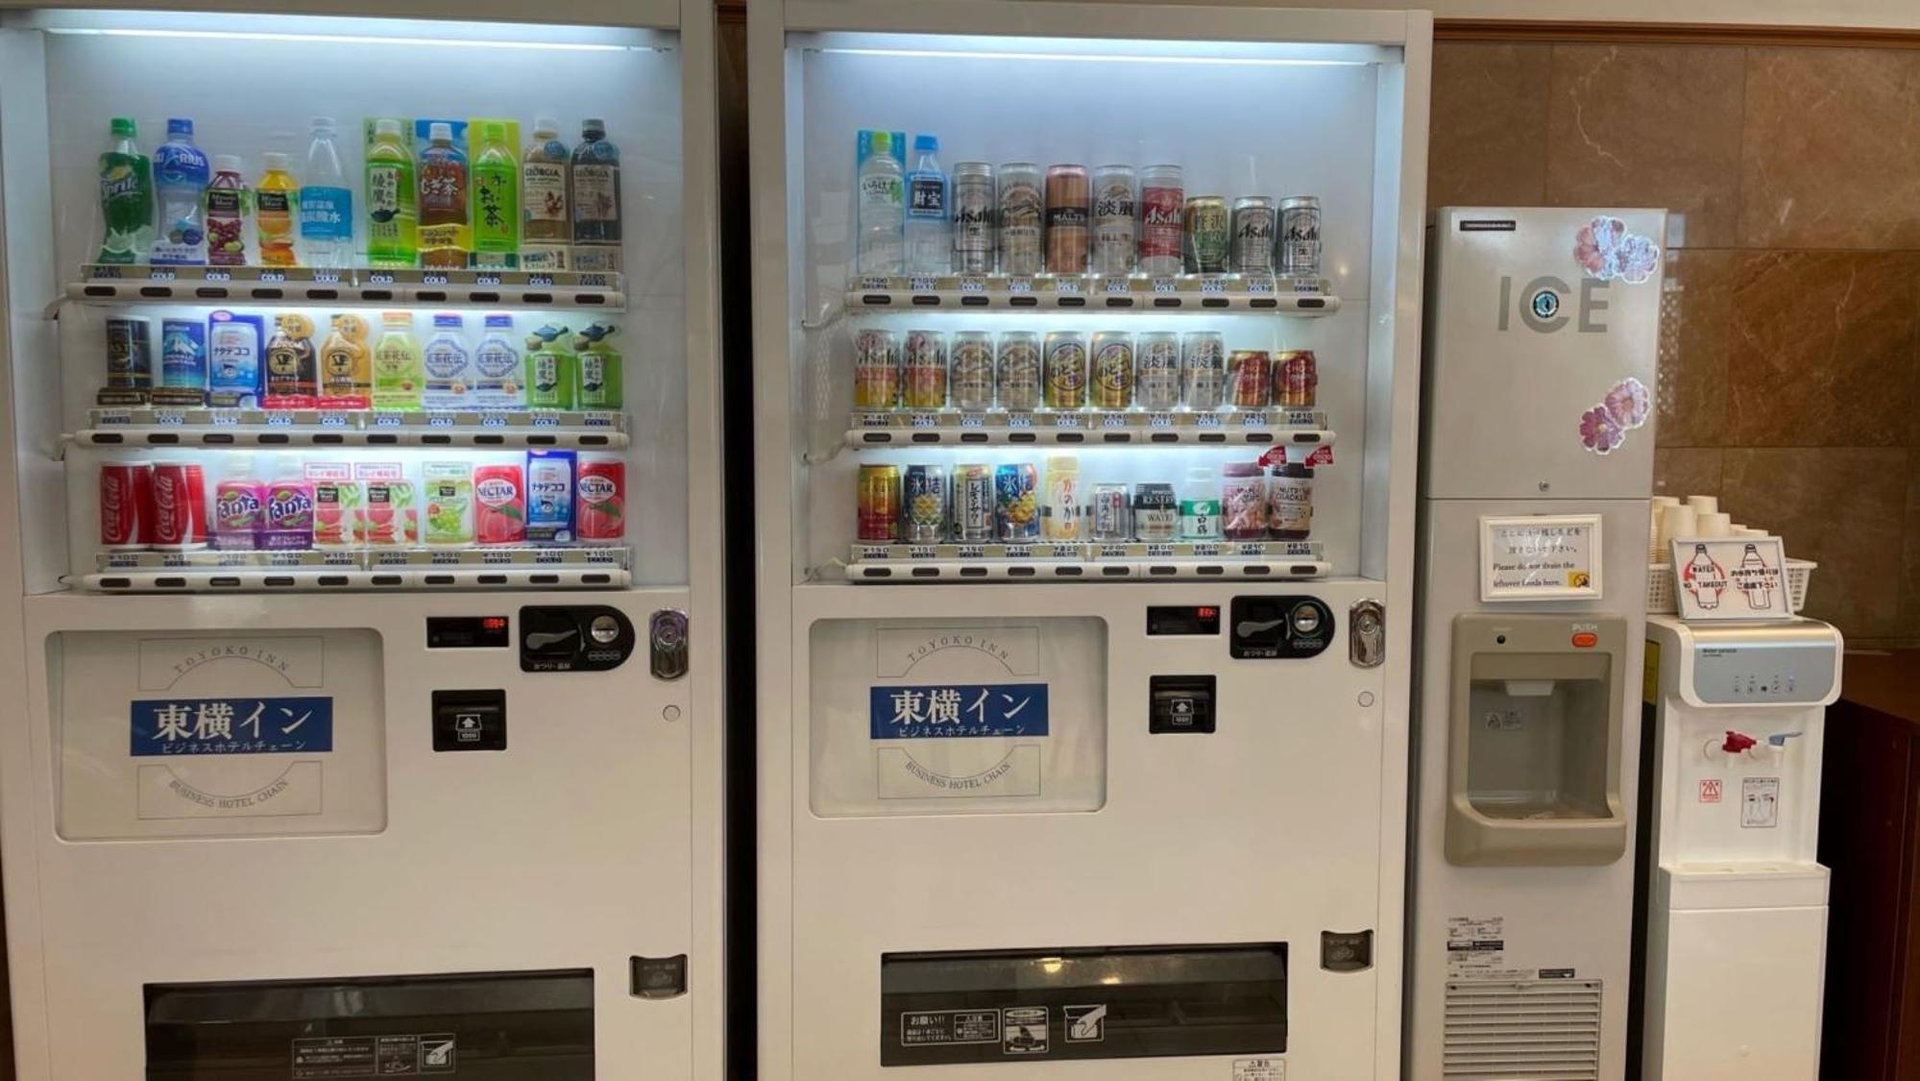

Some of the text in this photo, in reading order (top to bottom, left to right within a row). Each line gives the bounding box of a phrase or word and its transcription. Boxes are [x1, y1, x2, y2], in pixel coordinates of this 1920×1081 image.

[1498, 275, 1611, 333] ICE
[479, 485, 514, 496] NECTAR
[579, 483, 613, 494] NECTAR
[1563, 561, 1575, 569] the
[1692, 565, 1715, 573] WATER
[173, 645, 290, 674] TOYOKO INN
[907, 635, 1009, 662] TOYOKO INN
[890, 688, 1031, 726] 東横イン
[152, 701, 314, 741] 東横イン
[899, 724, 1025, 738] ビジネスホテルチェーン
[162, 740, 306, 754] ビジネスホテルチェーン
[905, 761, 1012, 790] BUSINESS HOTEL CHAIN
[168, 778, 289, 809] BUSINESS HOTEL CHAIN
